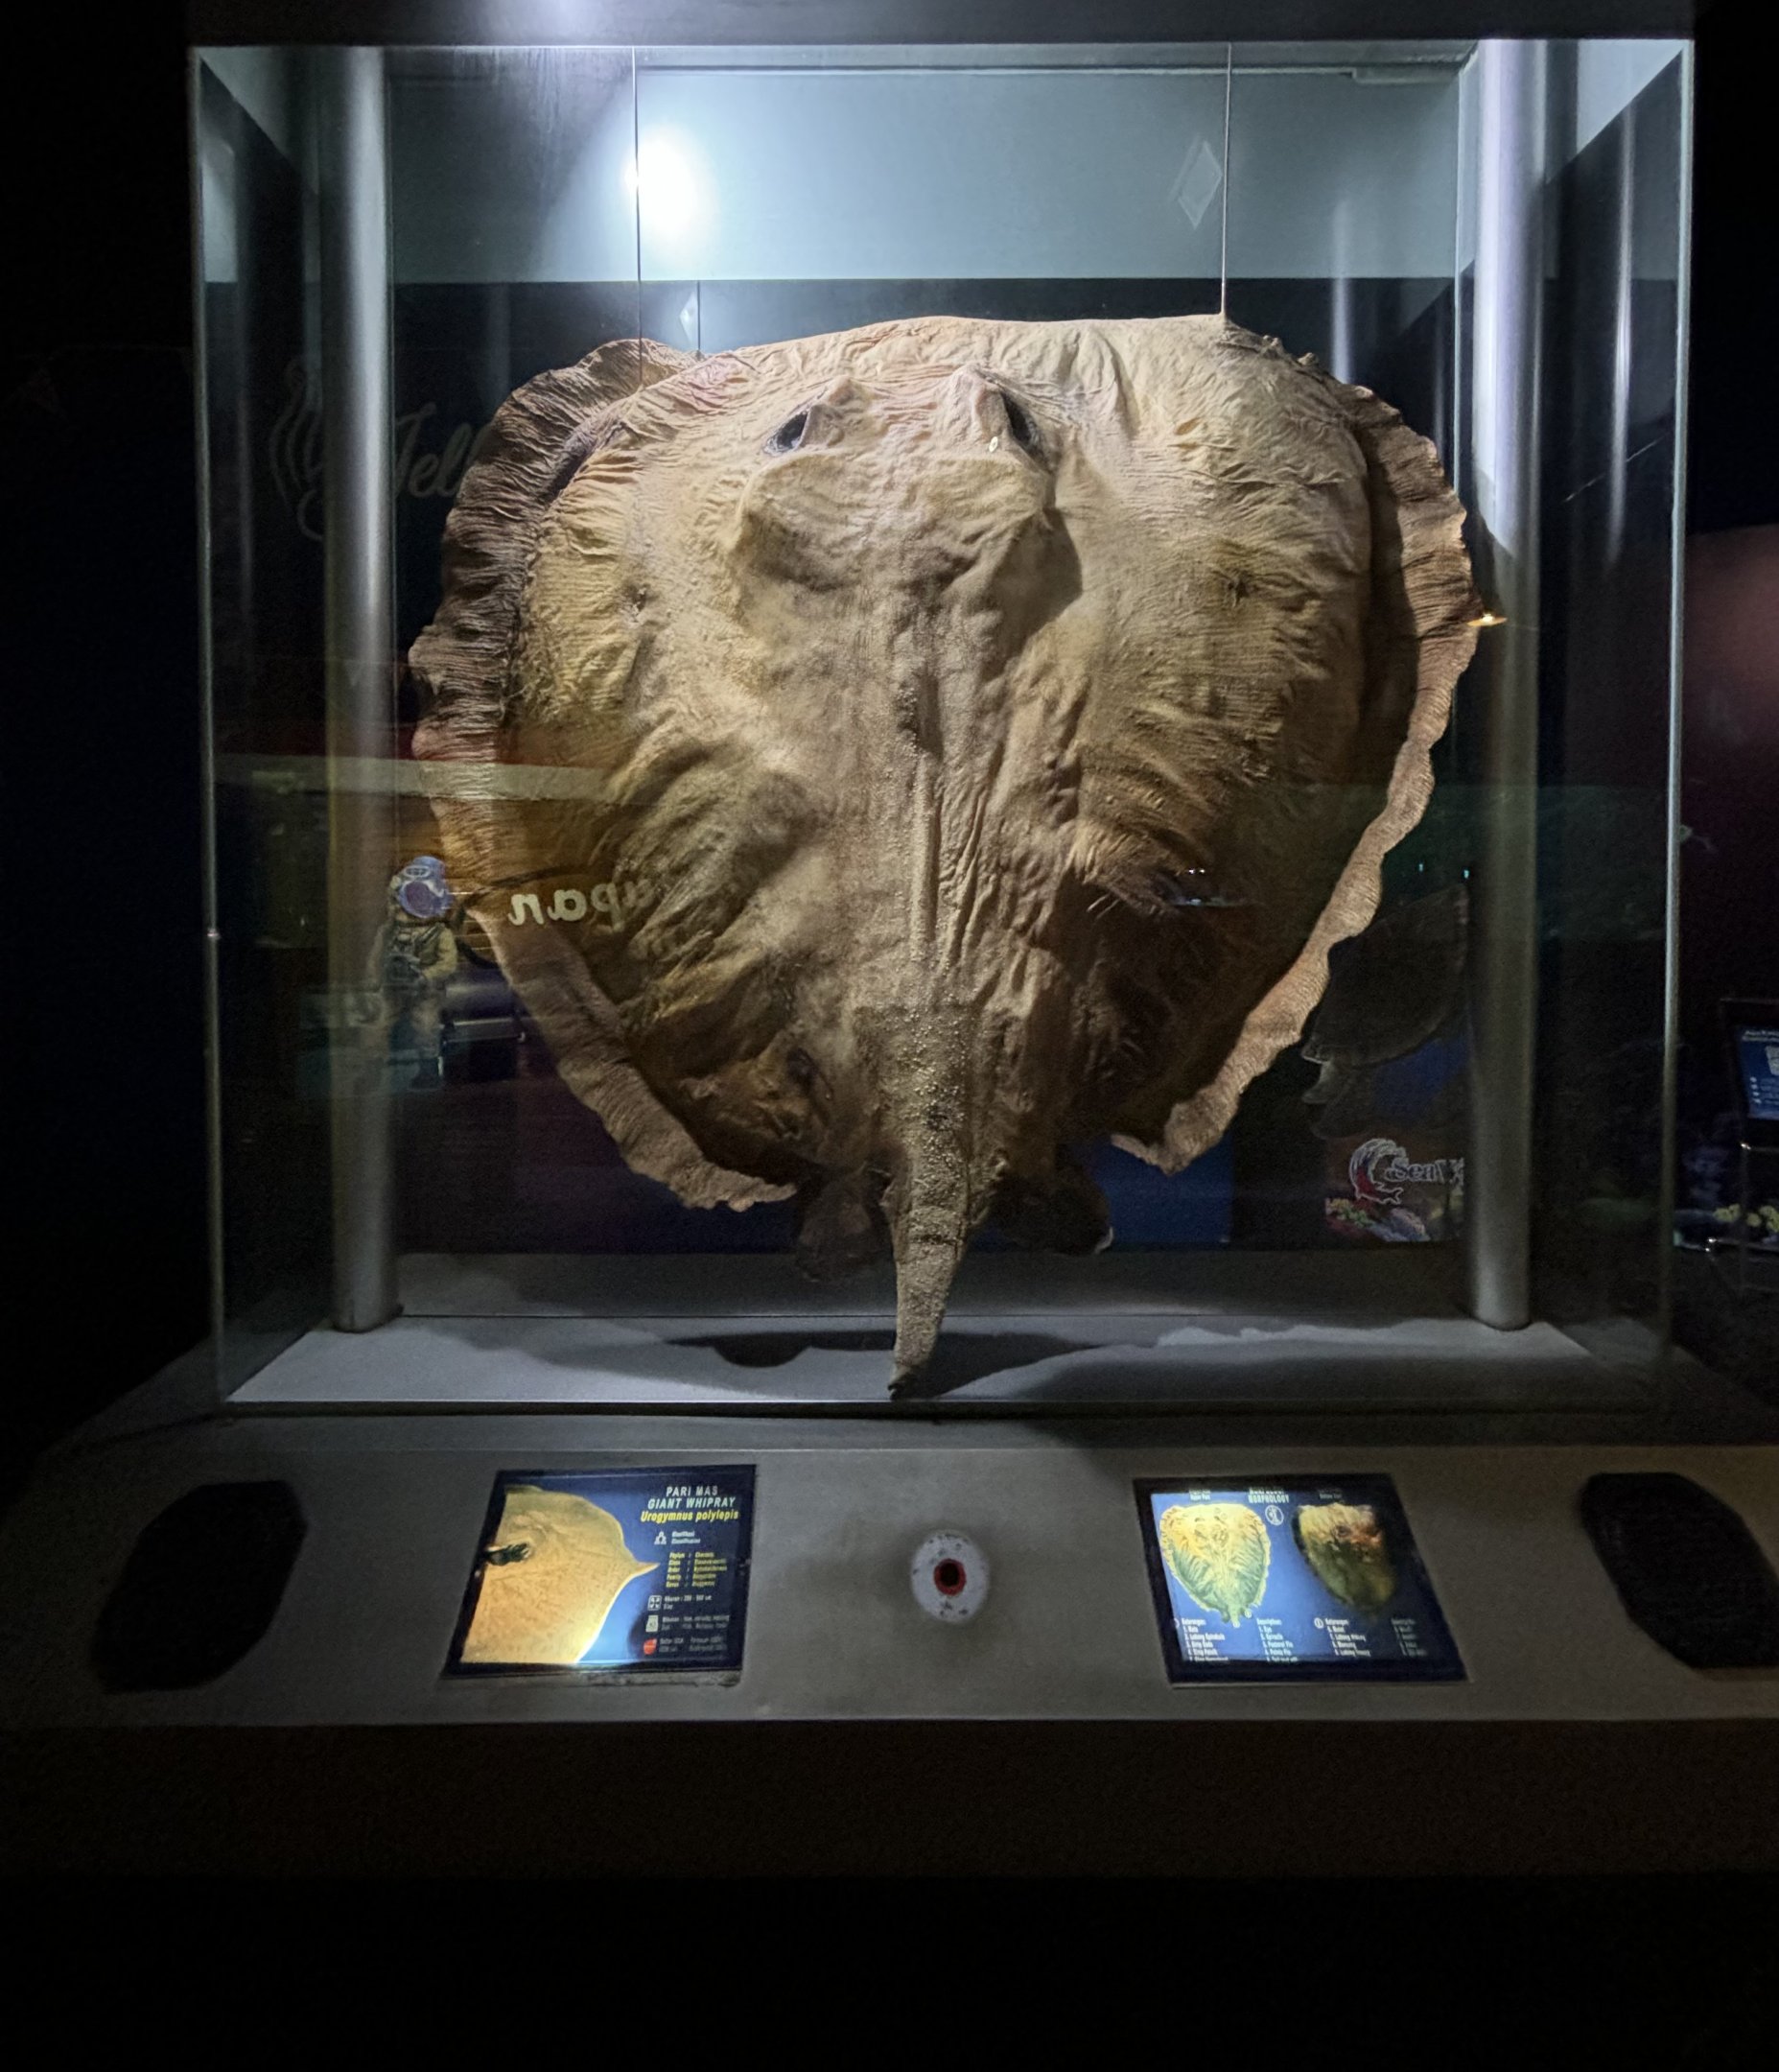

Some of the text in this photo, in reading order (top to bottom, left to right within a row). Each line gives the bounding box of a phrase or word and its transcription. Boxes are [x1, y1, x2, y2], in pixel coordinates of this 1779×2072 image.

[666, 1485, 718, 1497] PARI MAS
[647, 1496, 736, 1510] GIANT WHIPRAY
[640, 1509, 739, 1523] Urogymnus polylepis
